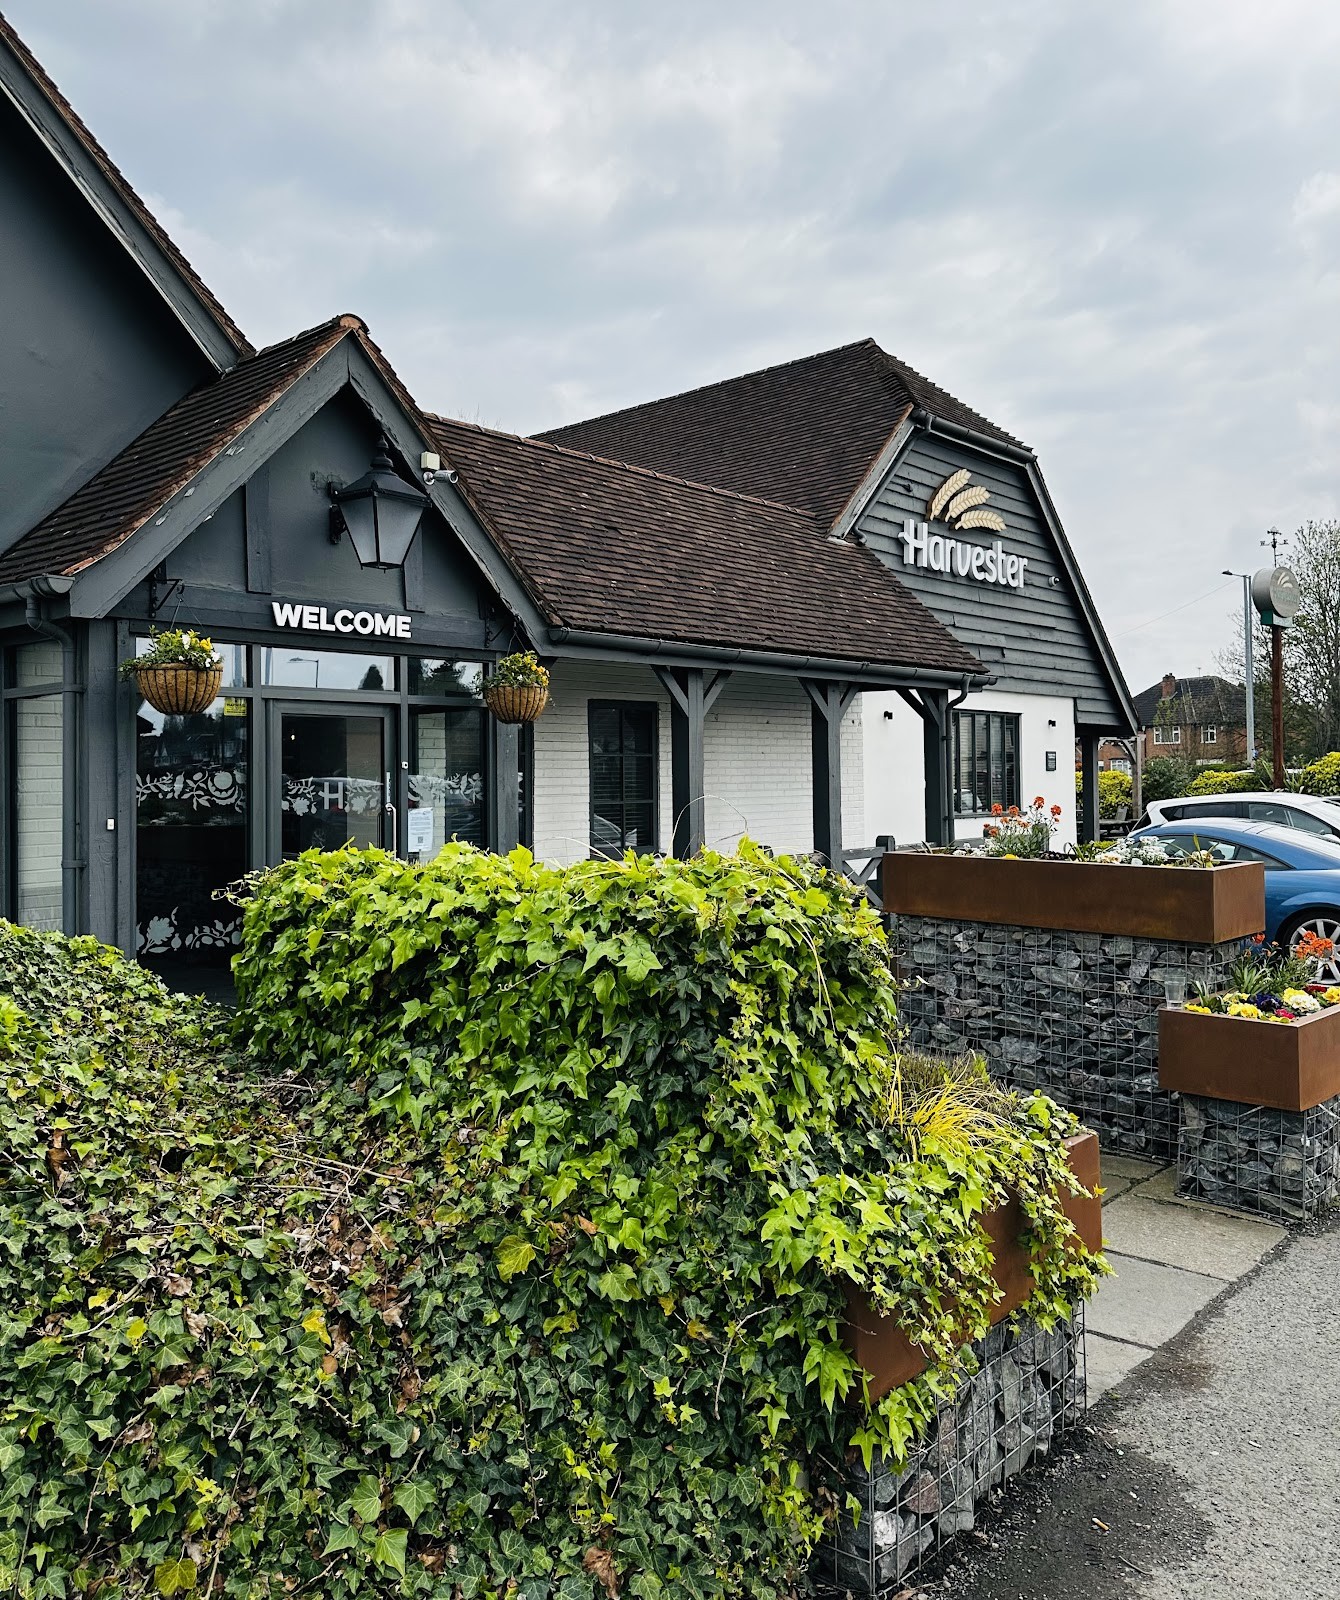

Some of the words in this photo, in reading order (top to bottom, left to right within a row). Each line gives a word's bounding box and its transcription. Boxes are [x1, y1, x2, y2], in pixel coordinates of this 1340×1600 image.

[898, 519, 1028, 588] Harvester
[272, 602, 411, 638] WELCOME
[318, 781, 344, 809] H
